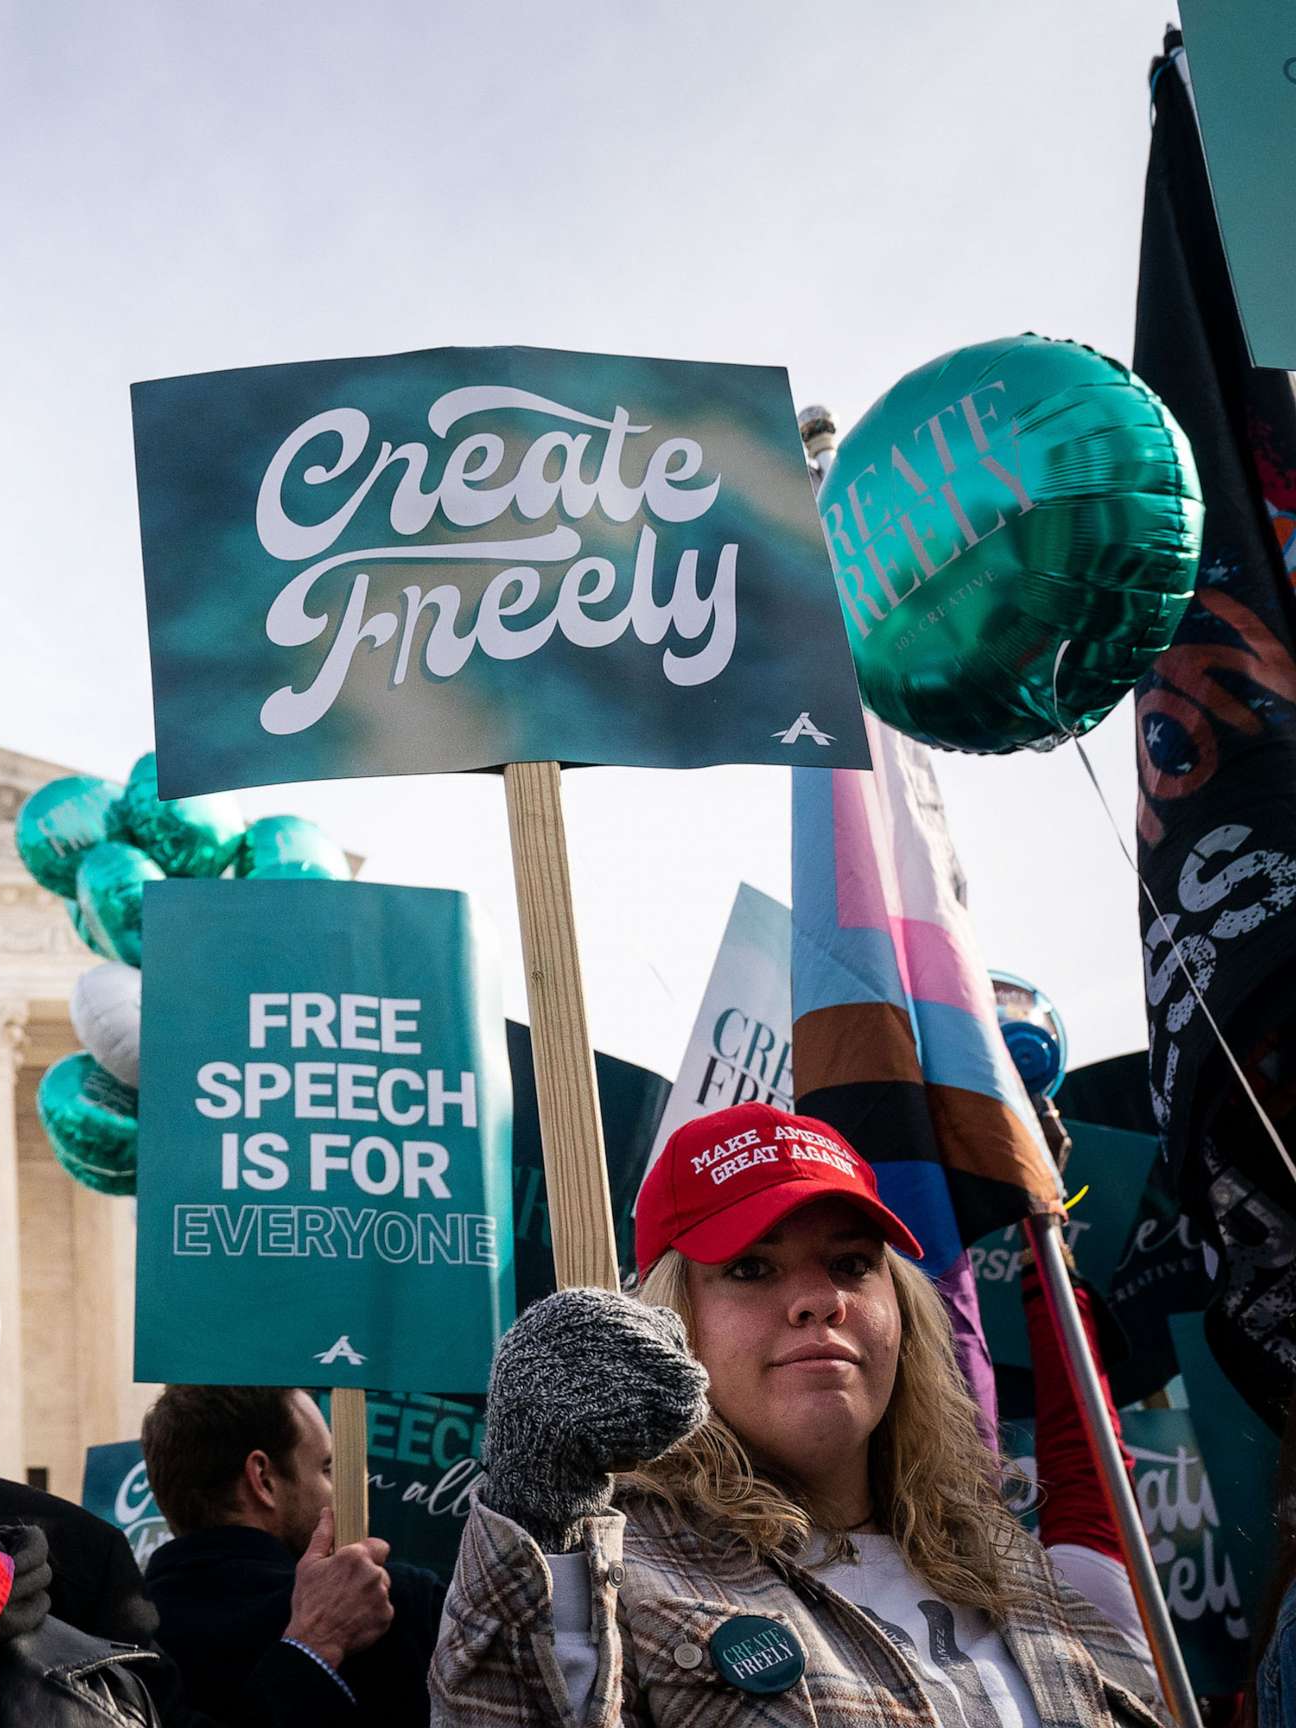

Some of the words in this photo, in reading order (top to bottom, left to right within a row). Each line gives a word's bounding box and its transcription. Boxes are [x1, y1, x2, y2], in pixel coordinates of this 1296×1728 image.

[256, 385, 722, 561] Create
[822, 379, 1005, 556] REATE
[838, 415, 1040, 640] REELY
[259, 523, 740, 735] Freely
[918, 567, 999, 634] CREATIVE
[249, 992, 422, 1055] FREE
[713, 1008, 794, 1101] CRE
[194, 1062, 478, 1128] SPEECH
[221, 1132, 289, 1190] IS
[309, 1133, 452, 1200] FOR
[690, 1129, 761, 1175] MAKE
[774, 1125, 859, 1167] AMERICA
[710, 1145, 779, 1186] GREAT
[790, 1143, 856, 1179] AGAIN
[173, 1204, 499, 1269] EVERYONE
[722, 1627, 786, 1666] CREATE
[732, 1641, 795, 1681] FREELY
